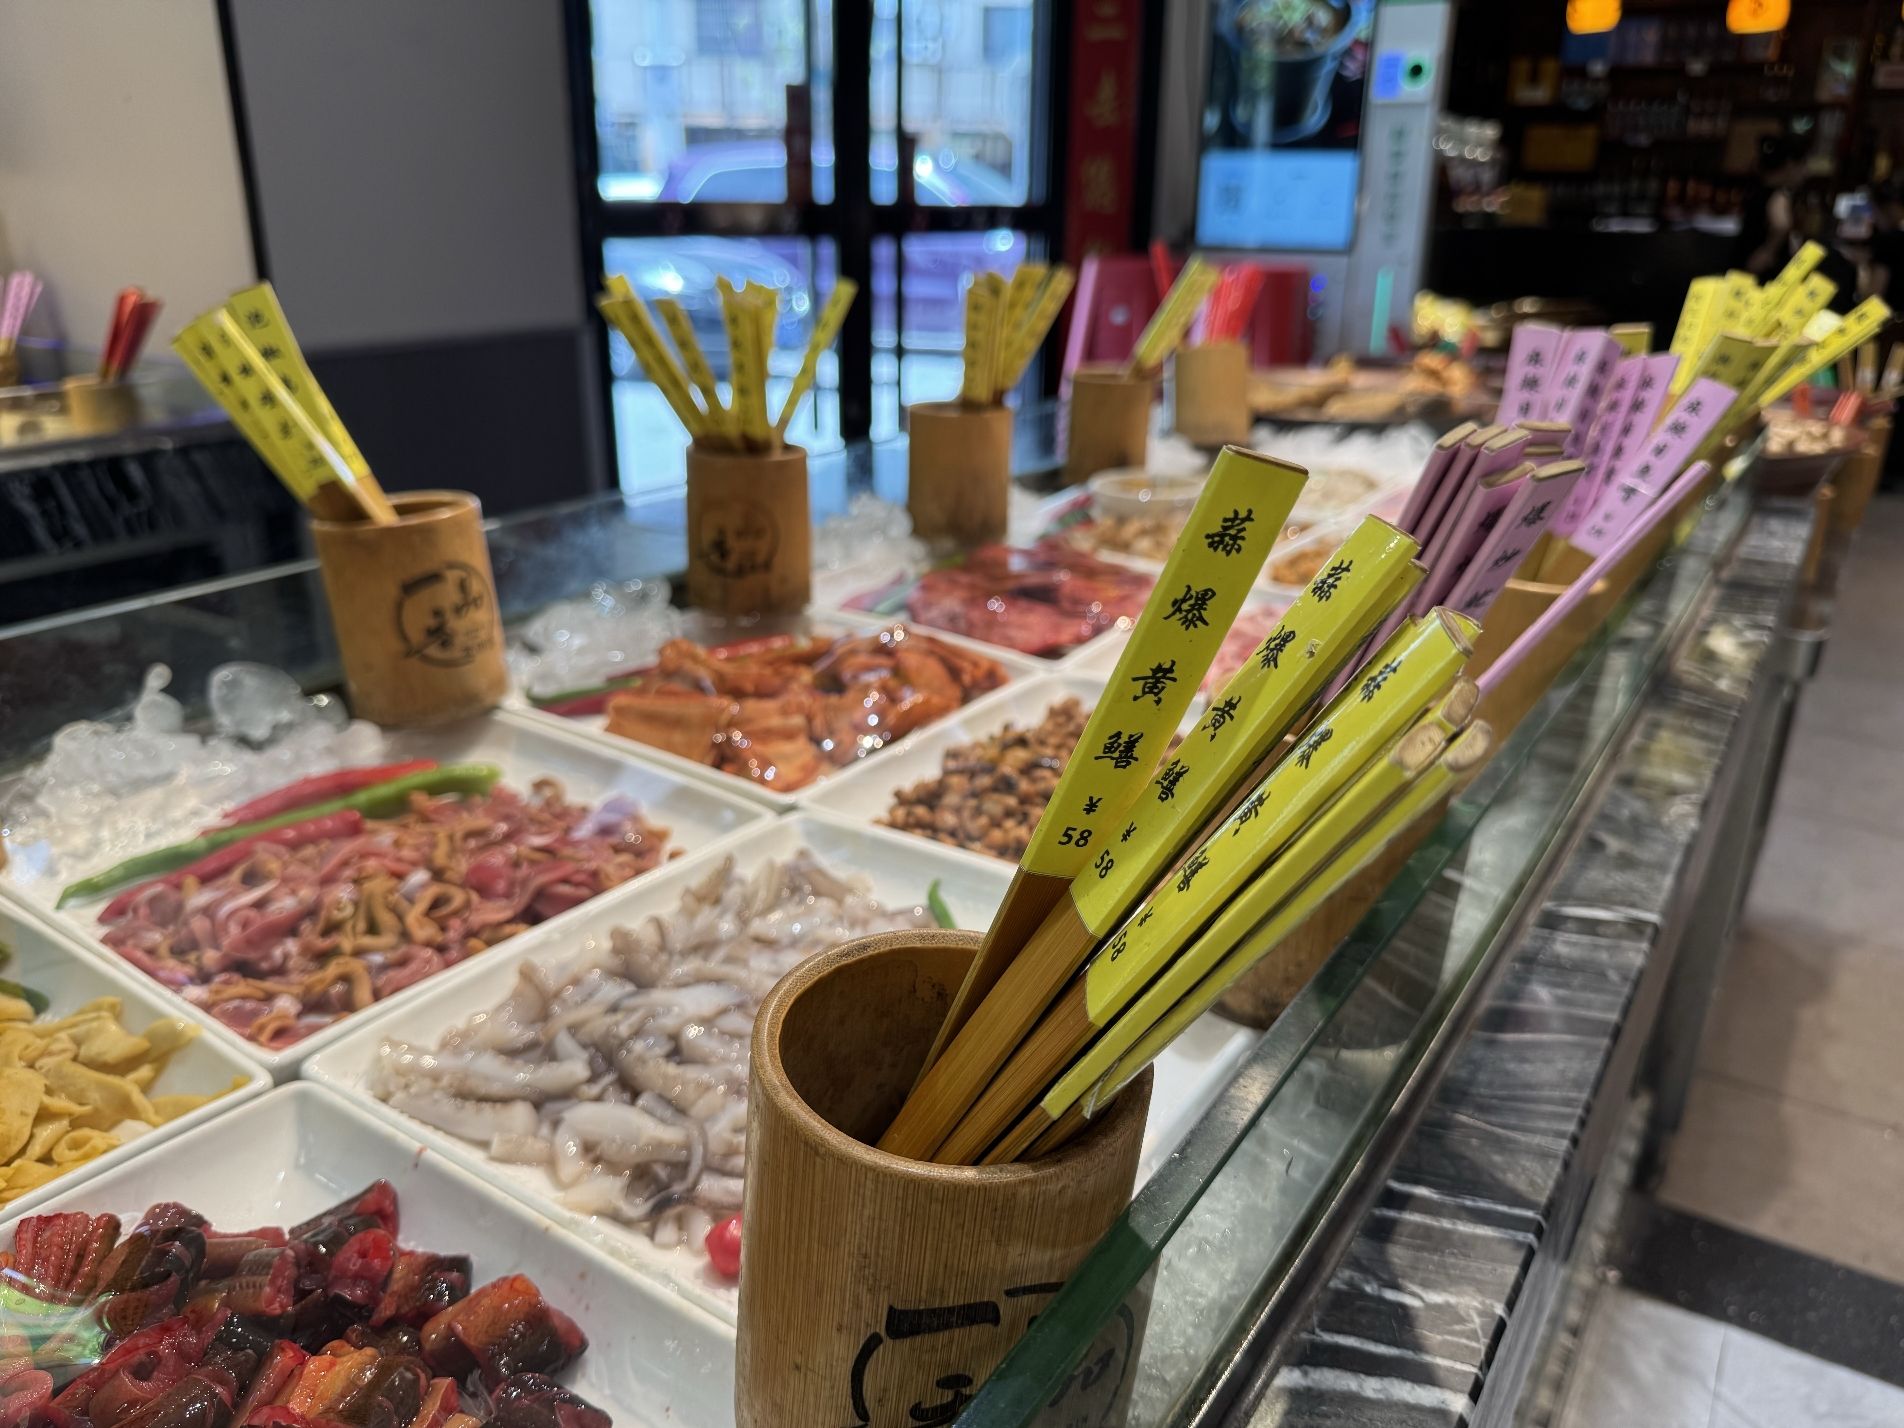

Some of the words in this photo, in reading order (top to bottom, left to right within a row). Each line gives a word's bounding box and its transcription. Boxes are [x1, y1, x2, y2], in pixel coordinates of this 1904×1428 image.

[1094, 508, 1255, 770] 蒜爆黄鳝
[1154, 559, 1353, 803] 蒜爆黄鳝
[1057, 827, 1093, 849] 58
[1095, 848, 1115, 879] 58
